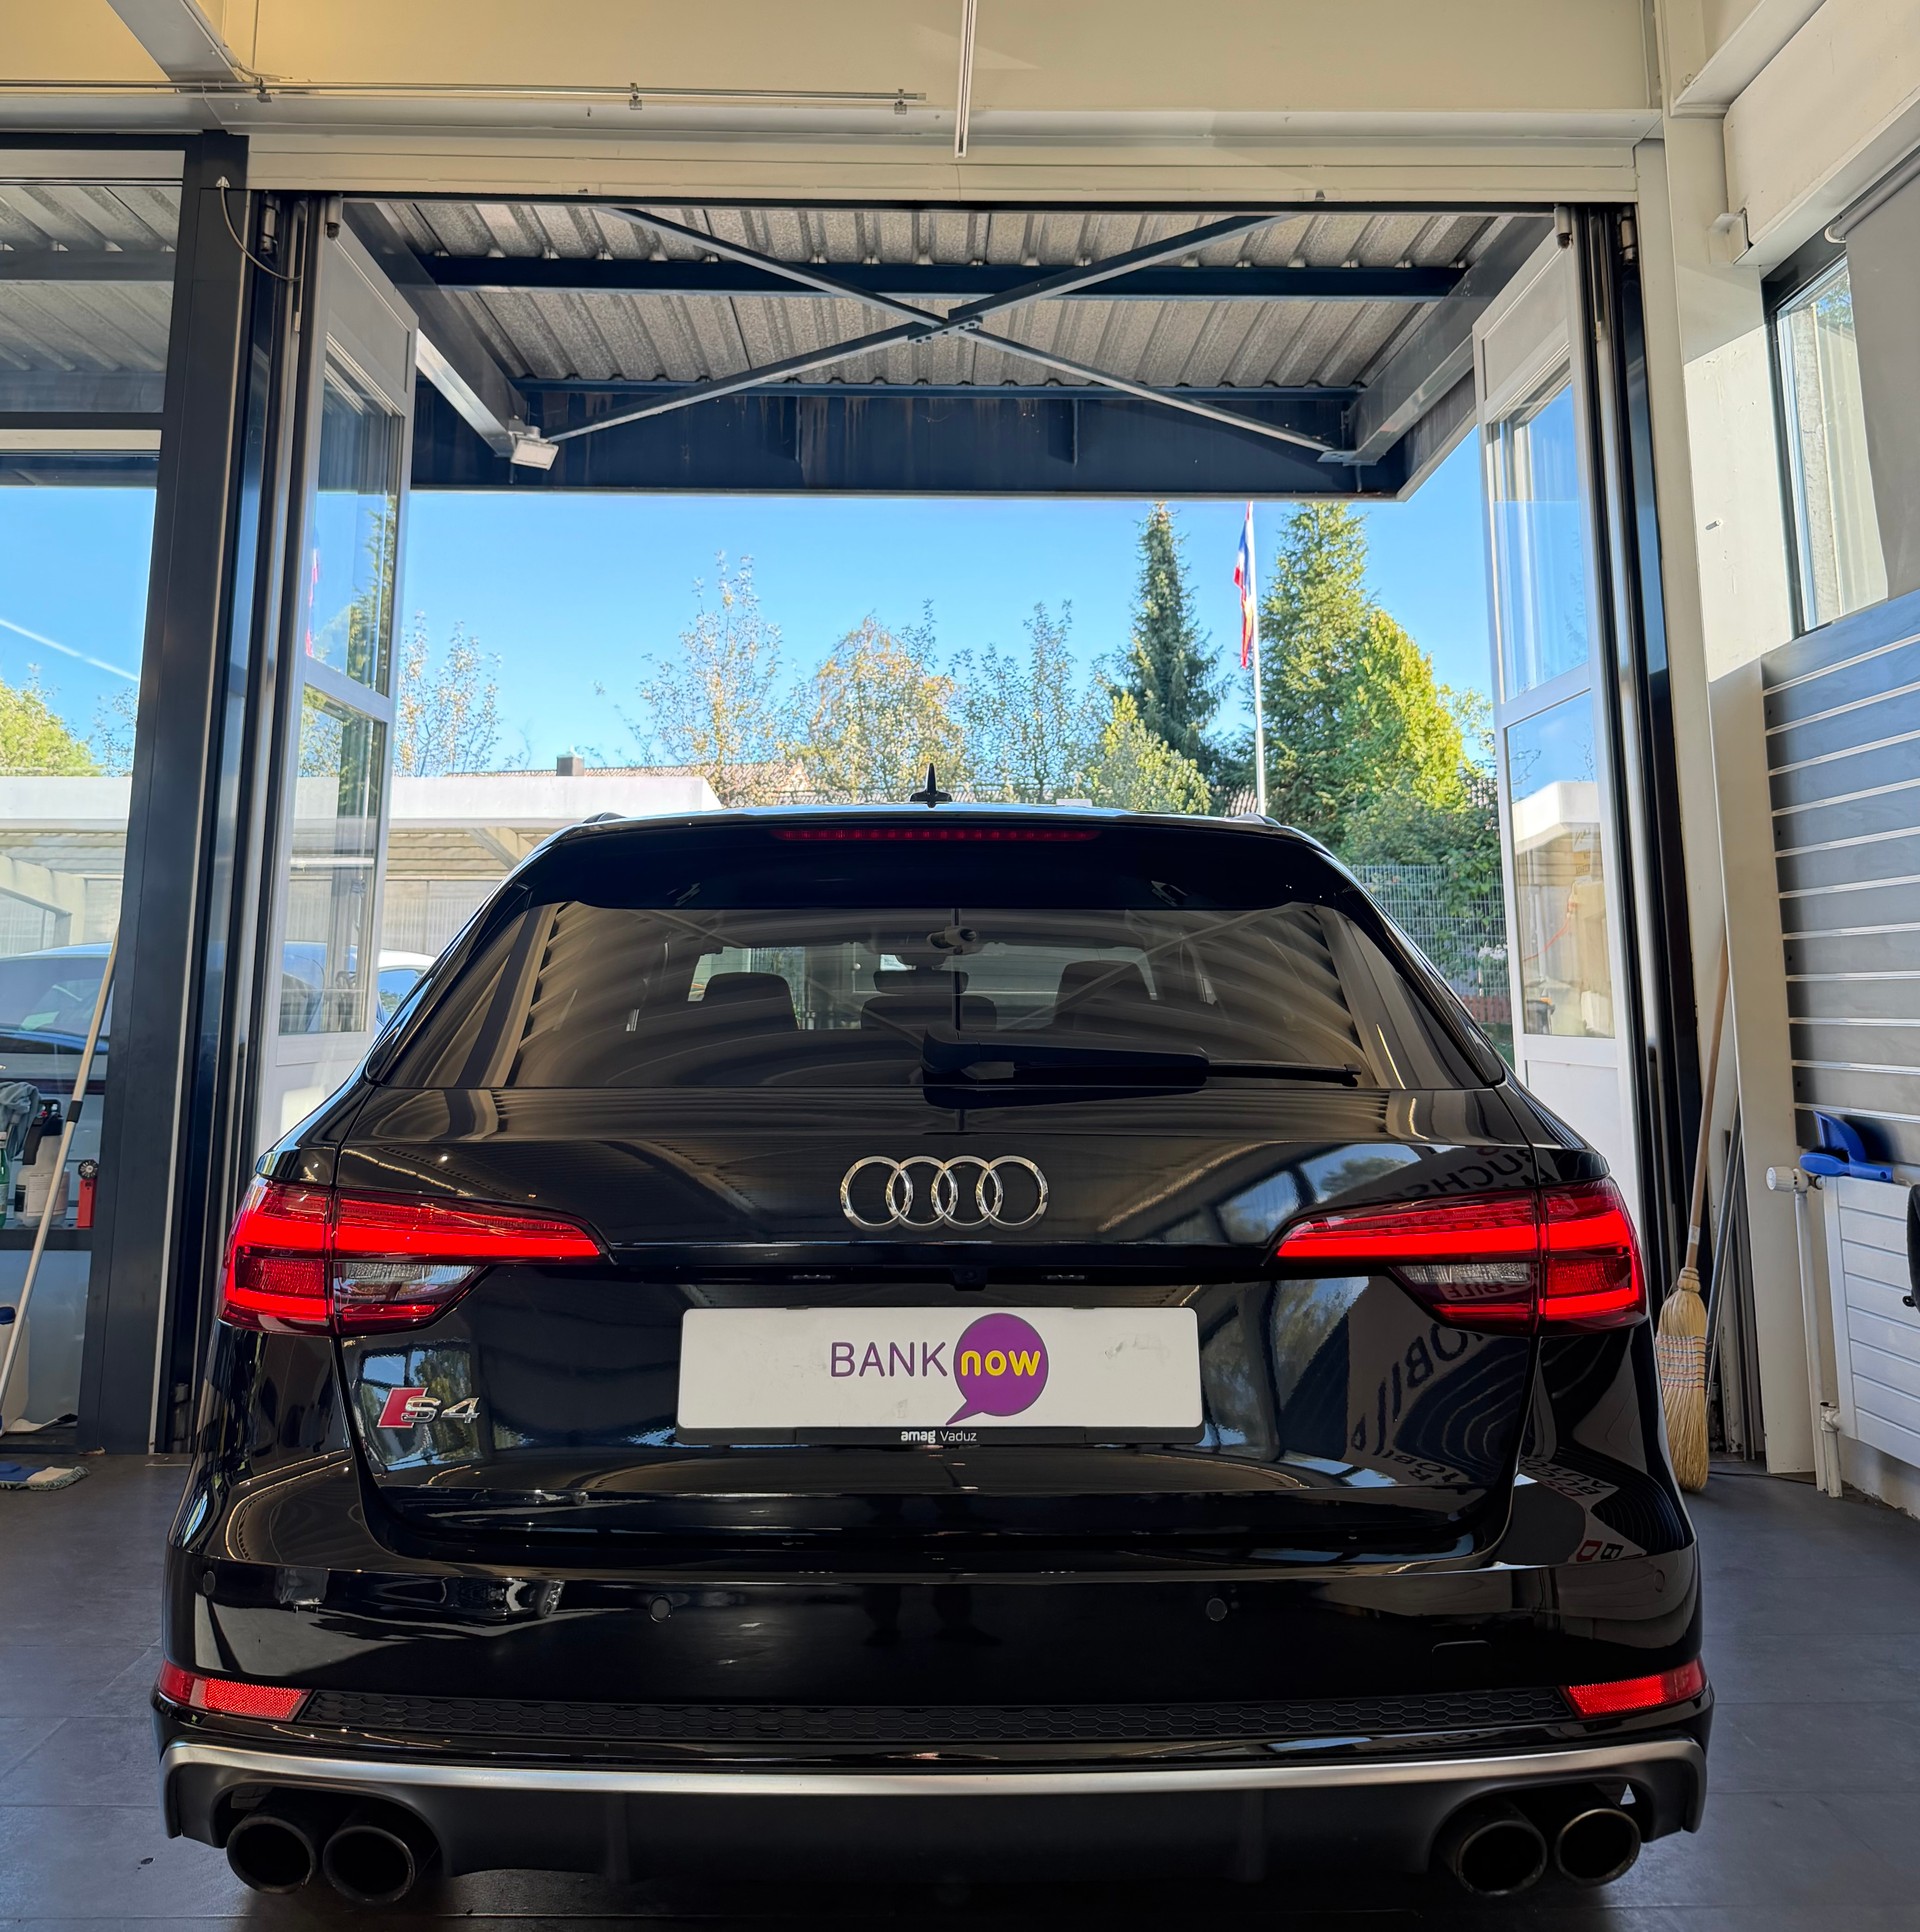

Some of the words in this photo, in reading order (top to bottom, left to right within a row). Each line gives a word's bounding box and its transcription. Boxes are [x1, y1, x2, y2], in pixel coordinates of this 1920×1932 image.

[831, 1342, 948, 1377] BANK
[961, 1350, 1041, 1377] now
[400, 1395, 480, 1424] S4
[900, 1430, 936, 1444] amag
[940, 1430, 977, 1442] Vaduz
